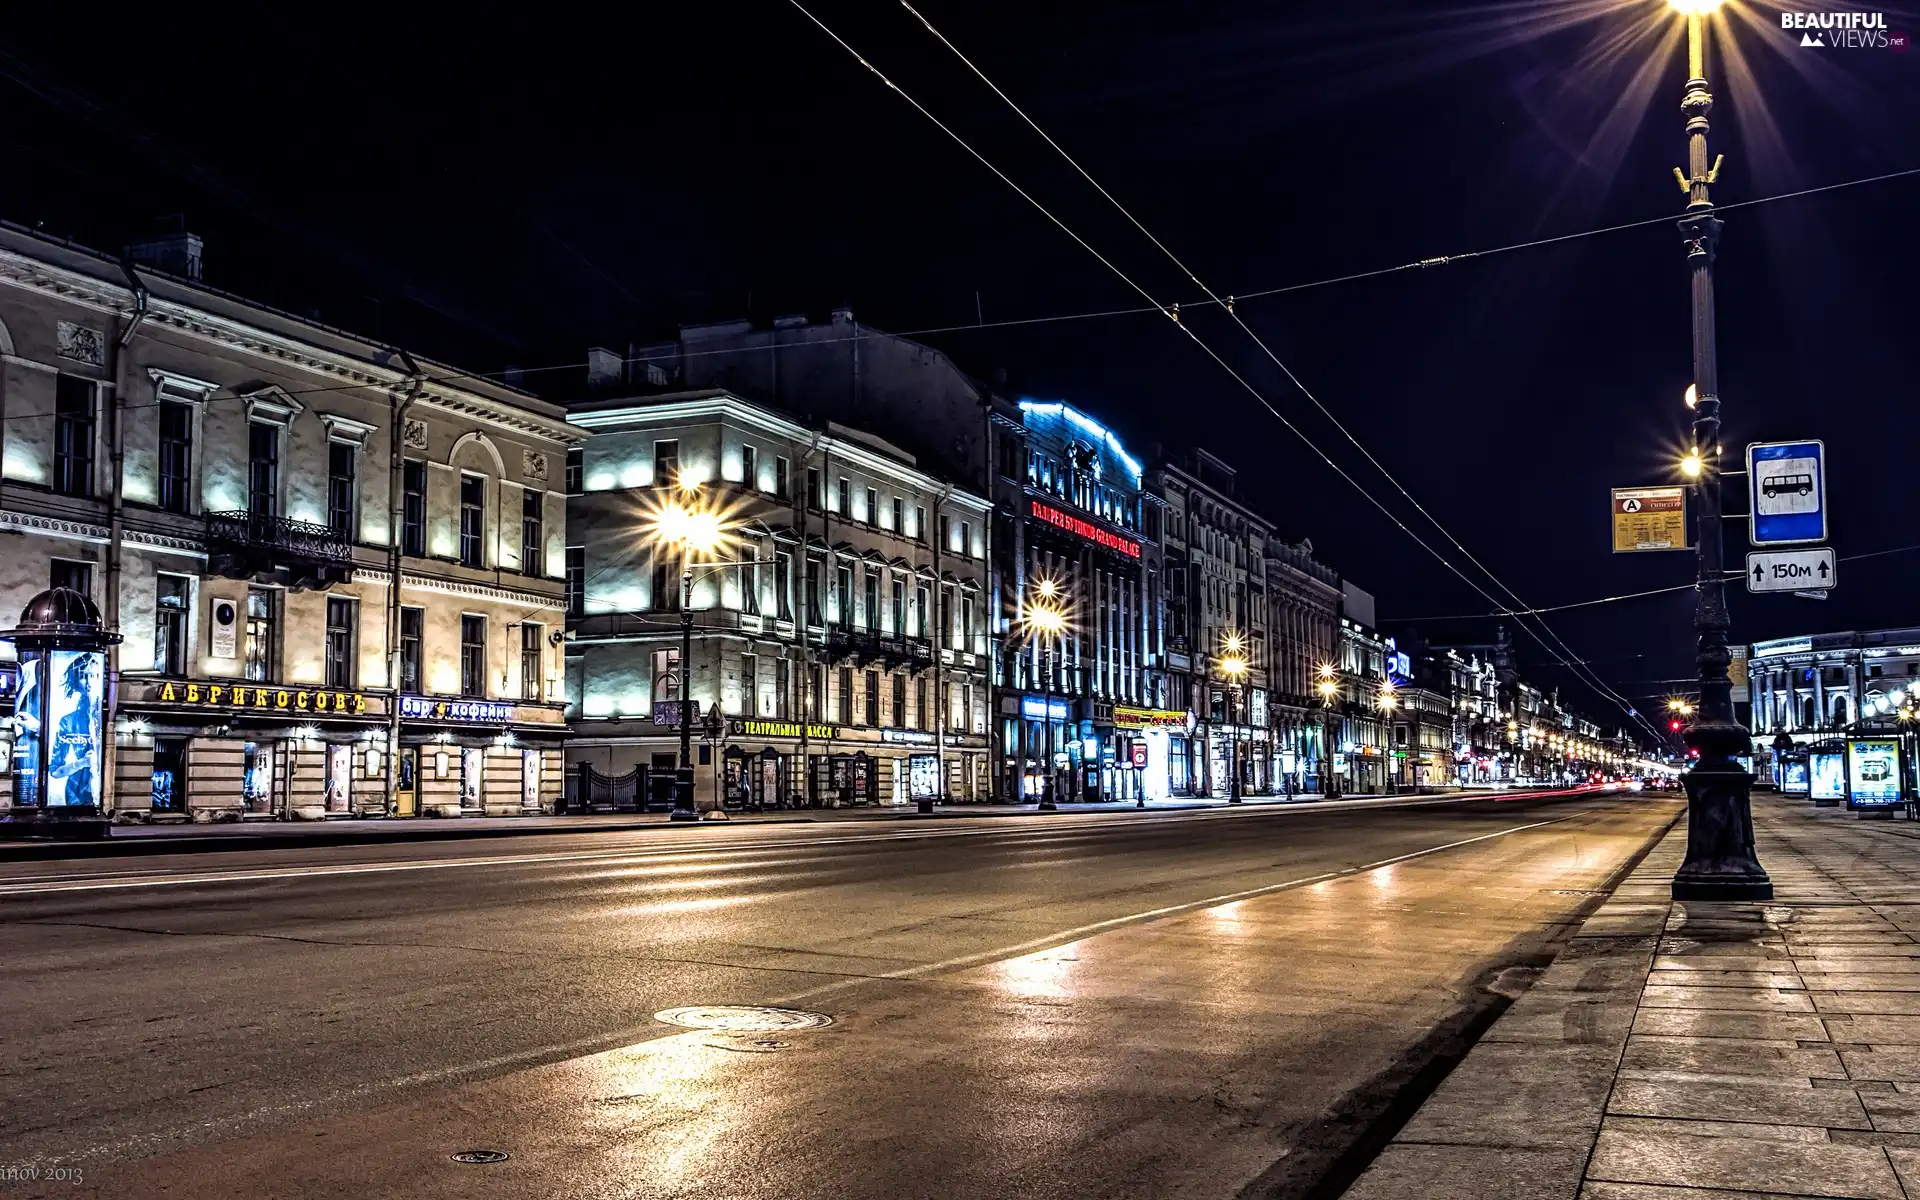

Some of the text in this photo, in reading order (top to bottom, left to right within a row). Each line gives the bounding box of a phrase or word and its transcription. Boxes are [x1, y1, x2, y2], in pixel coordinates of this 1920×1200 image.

[1032, 501, 1064, 527] ГАЛЕРЕЯ
[1096, 528, 1118, 549] GRAND
[1118, 538, 1140, 558] PALACE
[161, 681, 366, 712] АБРИКОСОВЪ
[402, 697, 430, 717] бар
[451, 702, 512, 720] кофейня
[744, 721, 832, 739] ТЕАТРАЛЬНАЯ КАССА
